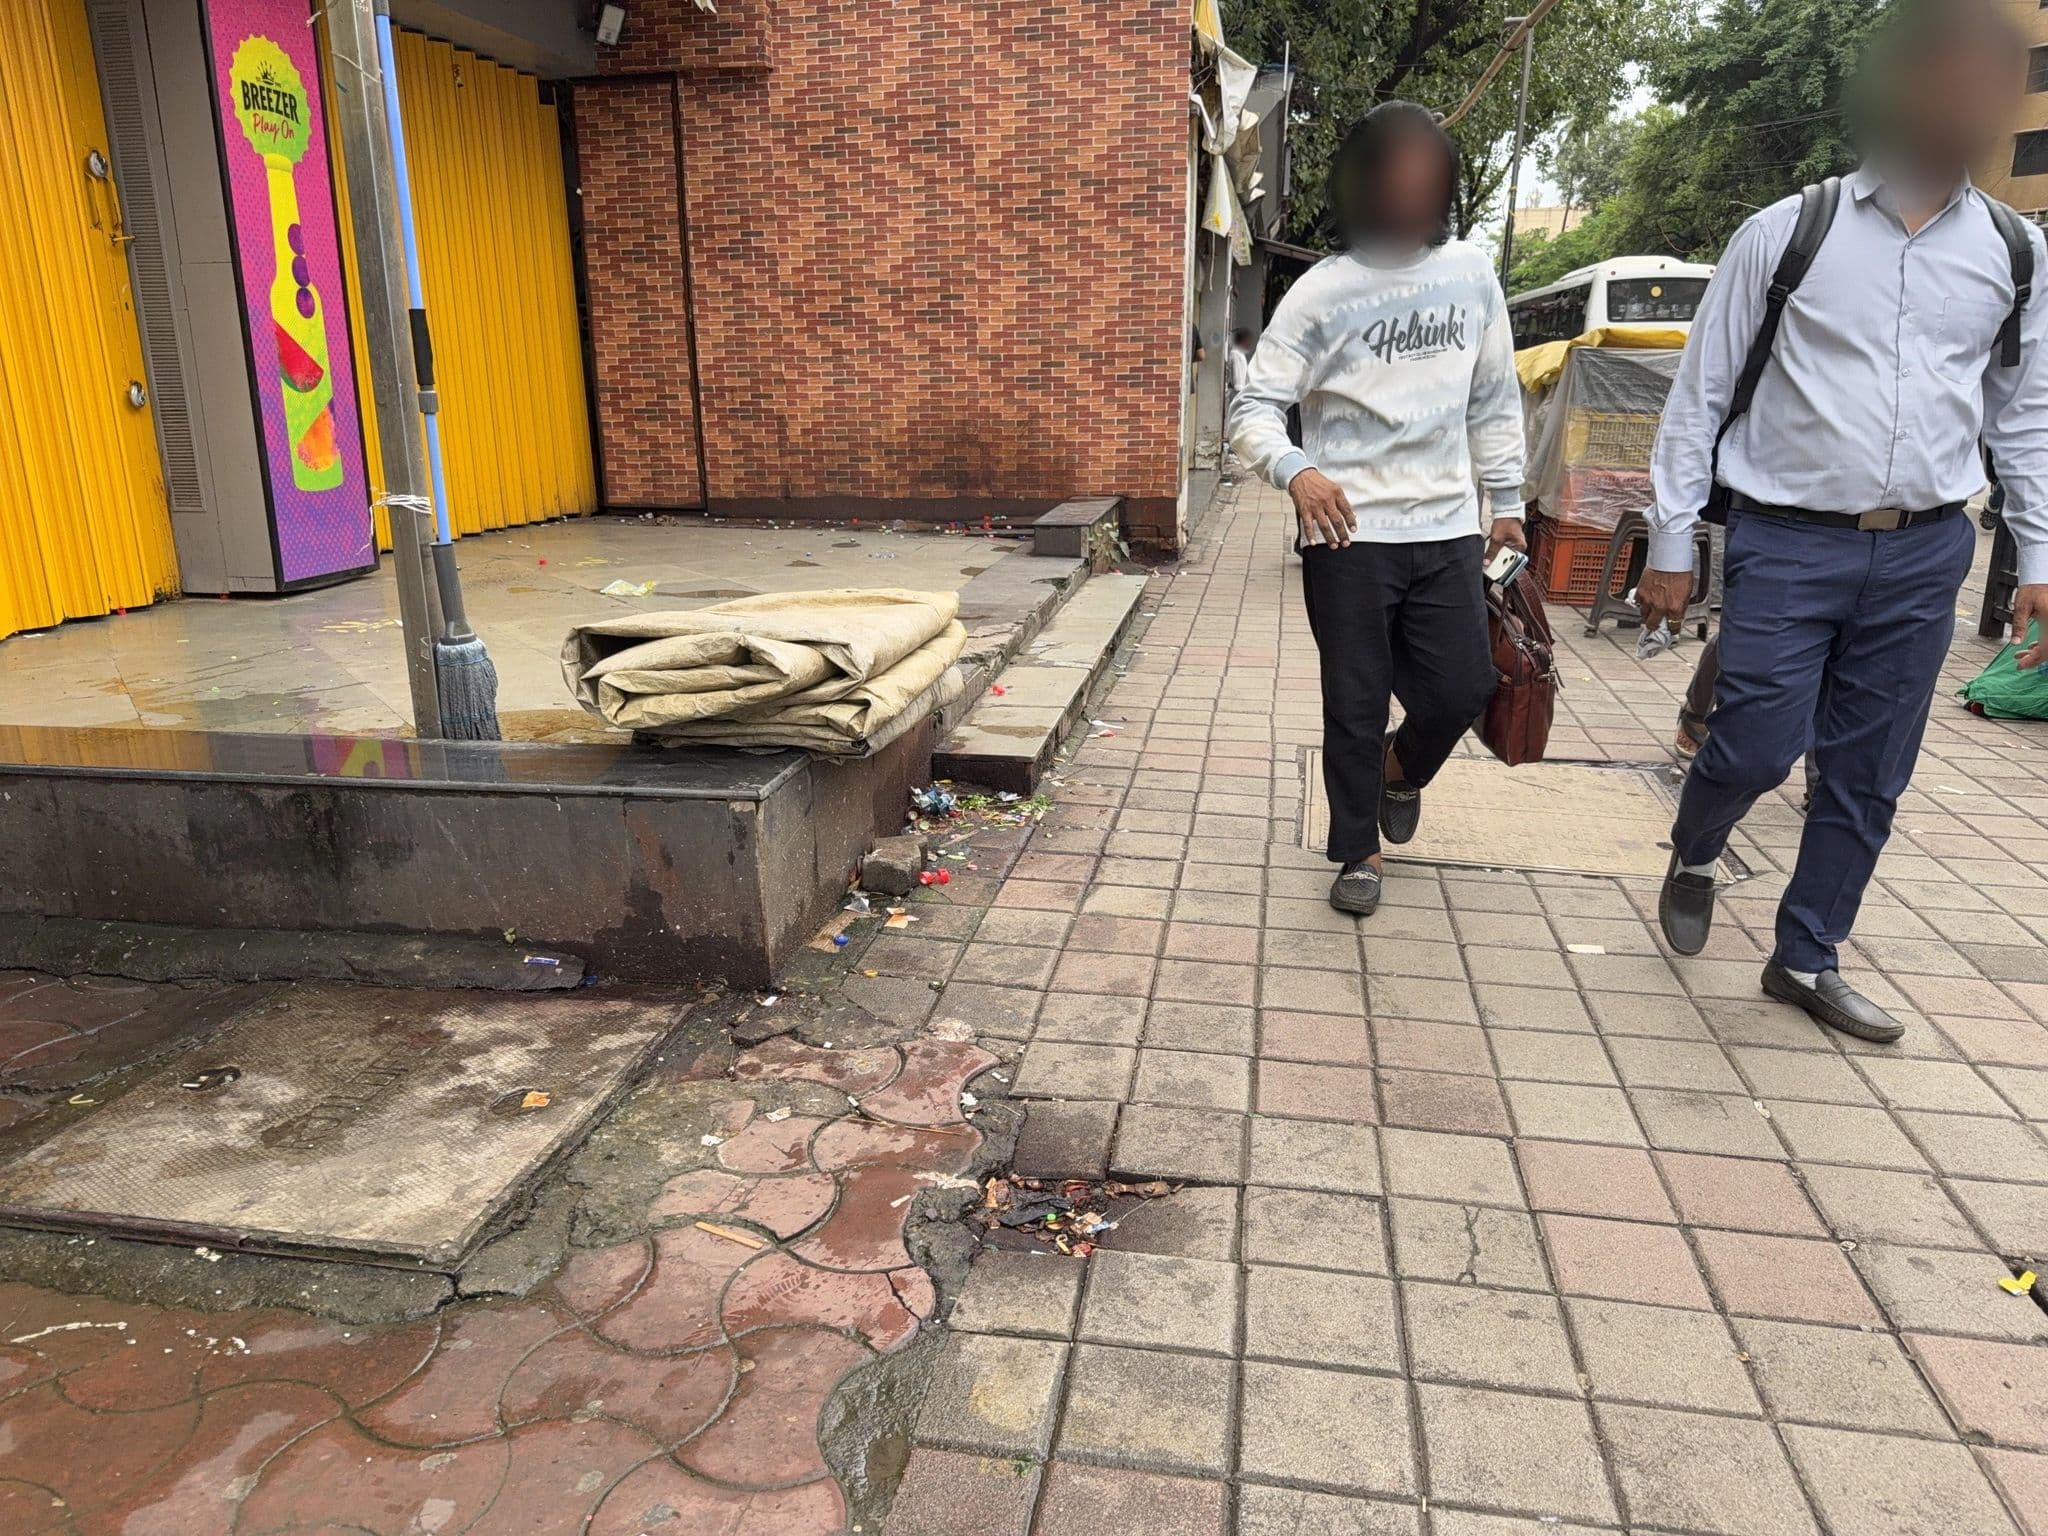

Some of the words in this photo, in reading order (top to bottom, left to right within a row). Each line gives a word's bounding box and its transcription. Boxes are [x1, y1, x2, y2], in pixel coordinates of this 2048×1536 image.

[241, 80, 301, 125] BREEZER
[253, 112, 279, 144] Play
[281, 119, 296, 140] On
[1362, 303, 1466, 365] Helsinki
